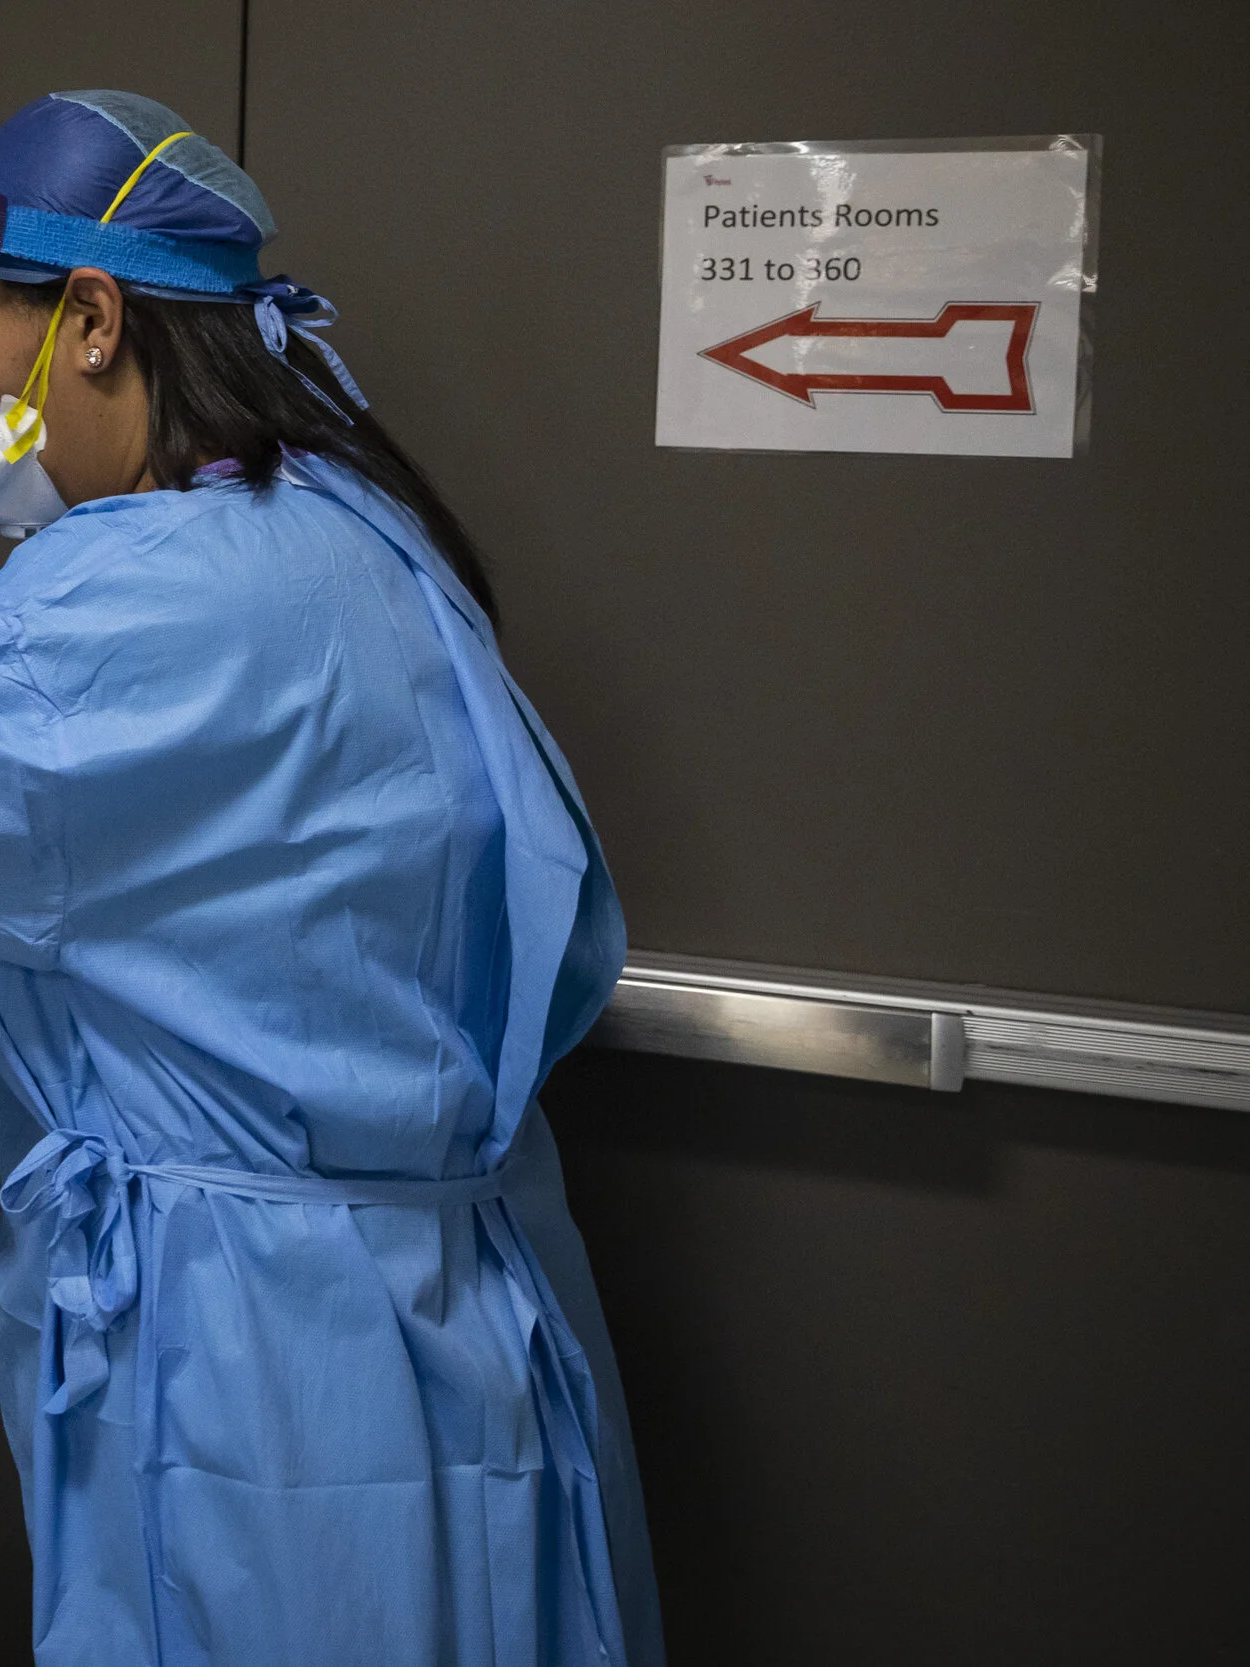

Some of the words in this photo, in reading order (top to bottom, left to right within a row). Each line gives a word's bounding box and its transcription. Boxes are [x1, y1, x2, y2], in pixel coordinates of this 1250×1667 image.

[704, 204, 823, 228] Patients
[835, 204, 940, 227] Rooms
[701, 257, 754, 281] 331
[764, 259, 795, 281] to
[805, 257, 861, 281] 360
